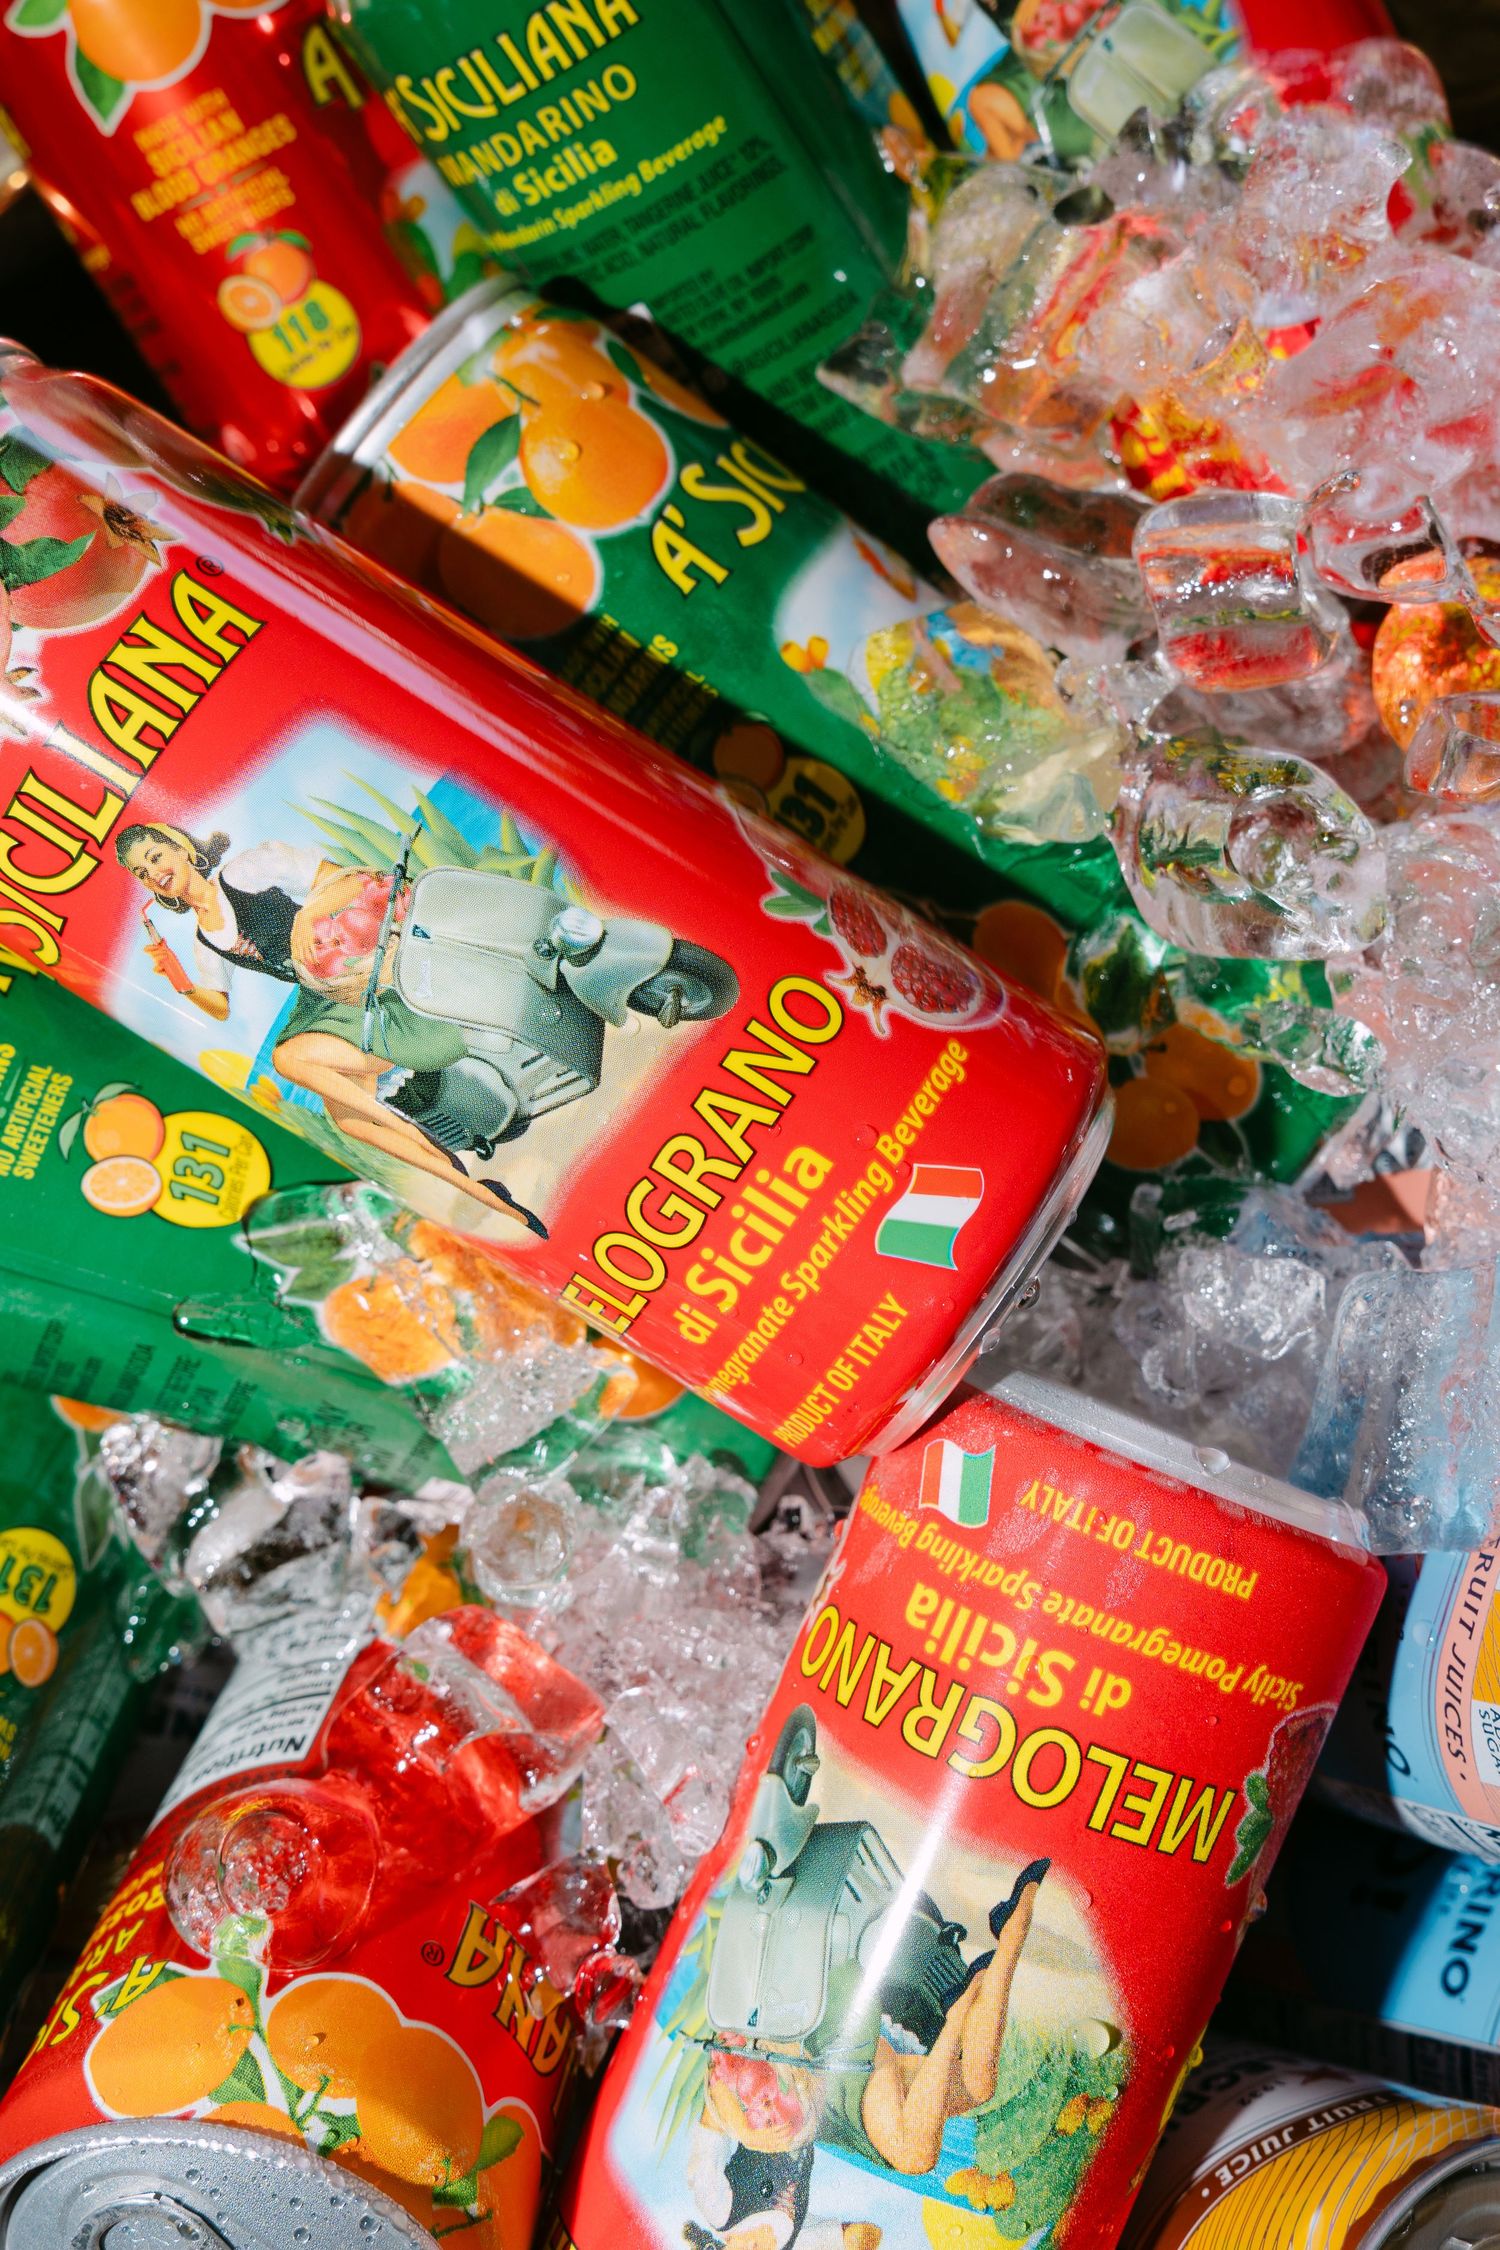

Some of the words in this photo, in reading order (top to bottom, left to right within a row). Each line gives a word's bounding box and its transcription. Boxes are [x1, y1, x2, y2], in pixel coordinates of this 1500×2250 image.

[384, 0, 641, 144] SICILIANA
[512, 139, 619, 207] Sicilia
[553, 173, 642, 229] Sparkling
[638, 115, 727, 183] Beverage
[273, 300, 329, 353] 118
[1, 1064, 53, 1150] ARTIFICIAL
[13, 1072, 73, 1180] SWEETENERS
[169, 1131, 231, 1206] 131
[557, 973, 846, 1338] ELOGRANO
[779, 1160, 895, 1301] Sparkling
[875, 1039, 969, 1165] Beverage
[684, 1142, 834, 1315] Sicilia
[673, 1302, 719, 1345] di
[772, 1382, 840, 1448] PRODUCT
[826, 1356, 860, 1392] OF
[845, 1290, 910, 1367] ITALY
[1020, 1479, 1099, 1536] ITALY
[1096, 1515, 1136, 1550] OF
[915, 1522, 1043, 1611] Sparkling
[1133, 1530, 1259, 1600] PRODUCT
[904, 1582, 1076, 1708] Sicilia
[1042, 1590, 1244, 1695] Pomegranate
[1078, 1667, 1133, 1717] di
[1241, 1663, 1304, 1712] Sicily
[1444, 1642, 1468, 1766] JUICES
[800, 1603, 1241, 1864] MELOGRANO
[1215, 2127, 1294, 2187] JUICE
